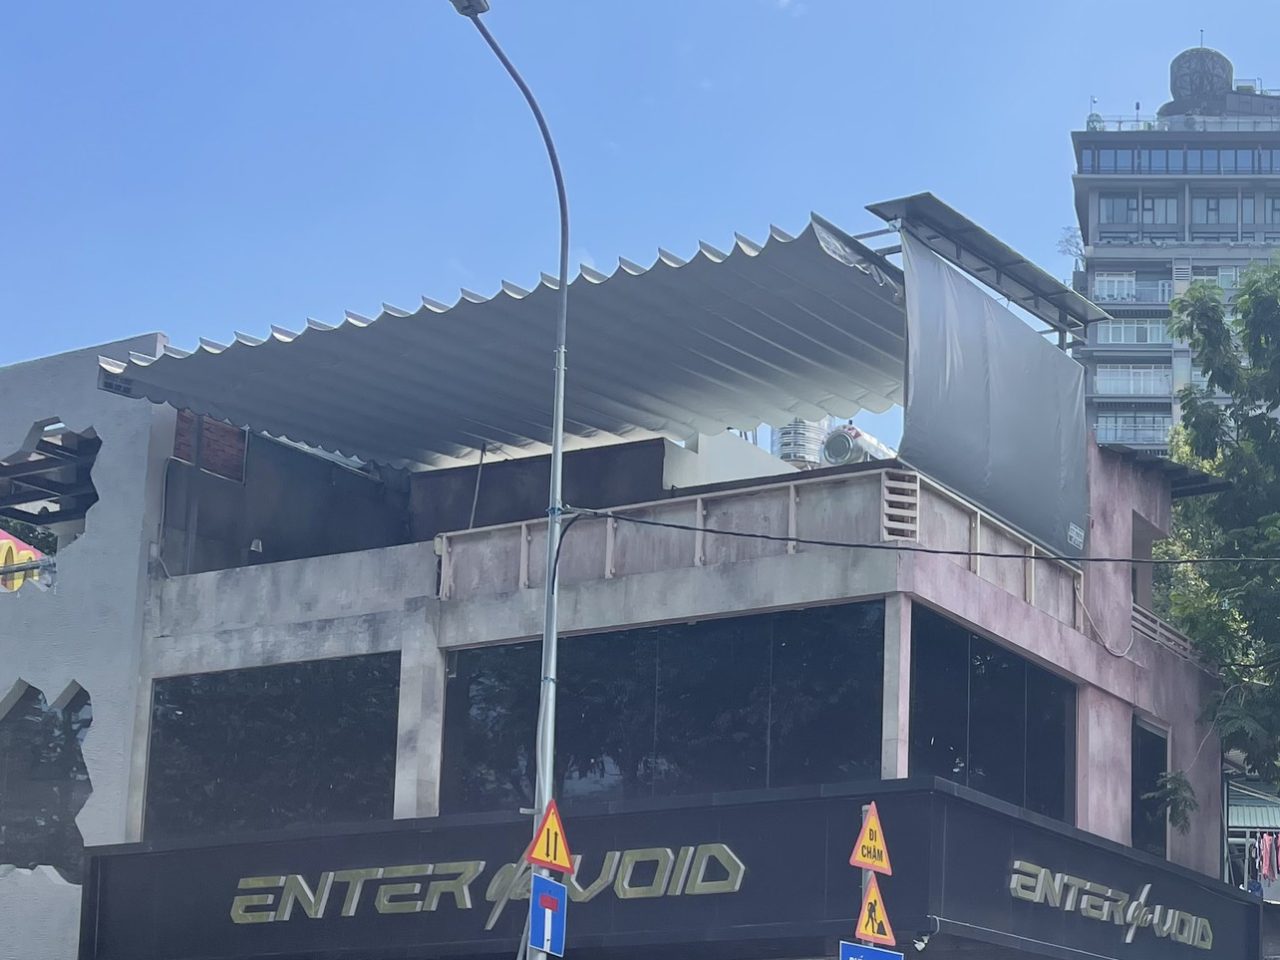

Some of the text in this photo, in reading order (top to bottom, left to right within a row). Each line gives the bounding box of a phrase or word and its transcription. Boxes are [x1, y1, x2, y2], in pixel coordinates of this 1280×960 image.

[861, 844, 883, 863] CHẬM
[868, 828, 877, 842] ĐI
[230, 861, 486, 923] ENTER
[562, 843, 745, 902] VOID
[1010, 860, 1129, 925] ENTER
[1153, 904, 1213, 950] VOID
